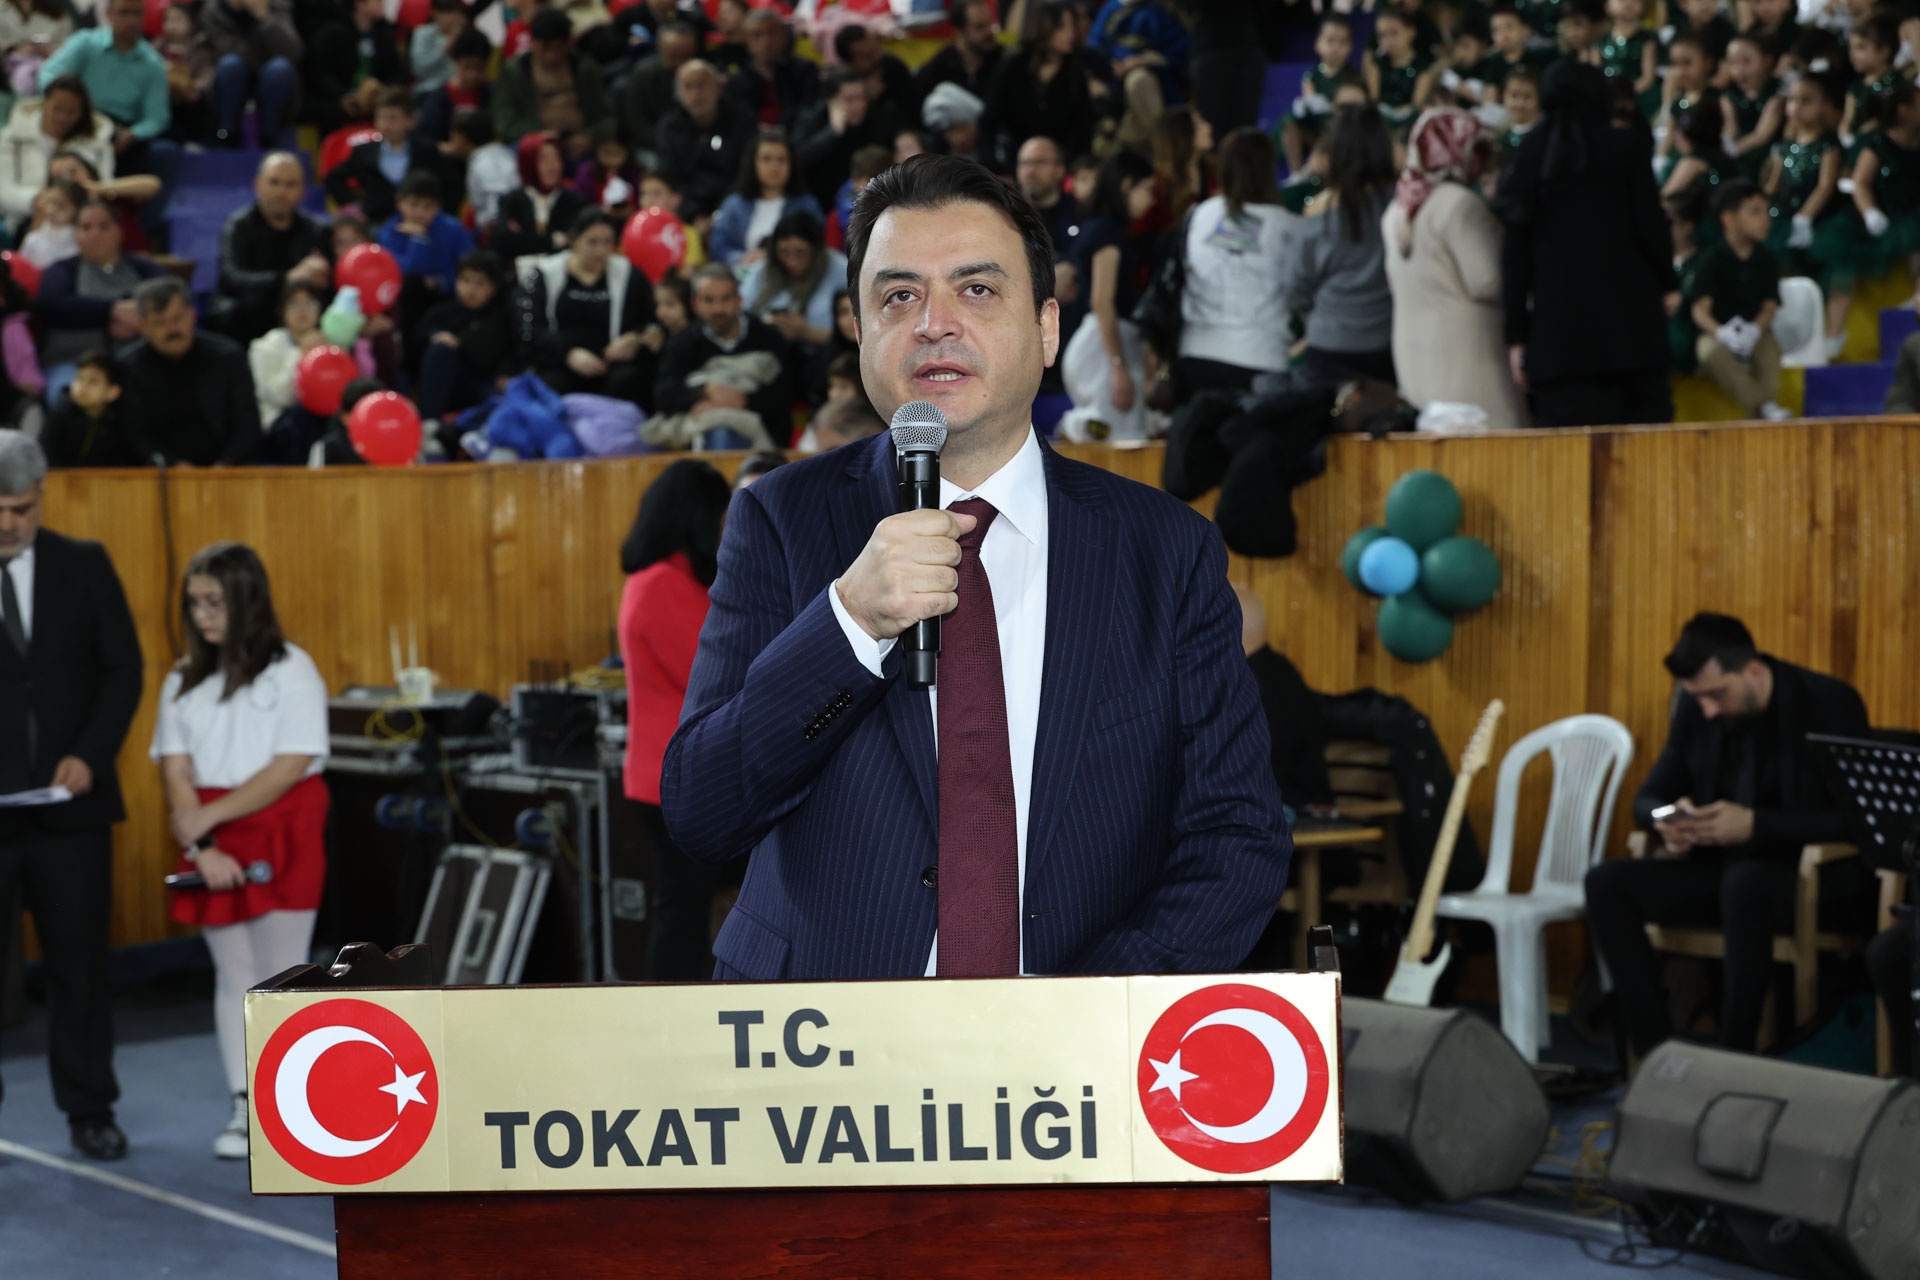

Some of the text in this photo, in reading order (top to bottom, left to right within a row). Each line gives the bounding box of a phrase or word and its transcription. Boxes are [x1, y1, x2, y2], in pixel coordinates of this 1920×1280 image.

[719, 1009, 854, 1068] T.C.
[484, 1086, 1097, 1169] TOKAT VALİLİĞİ
